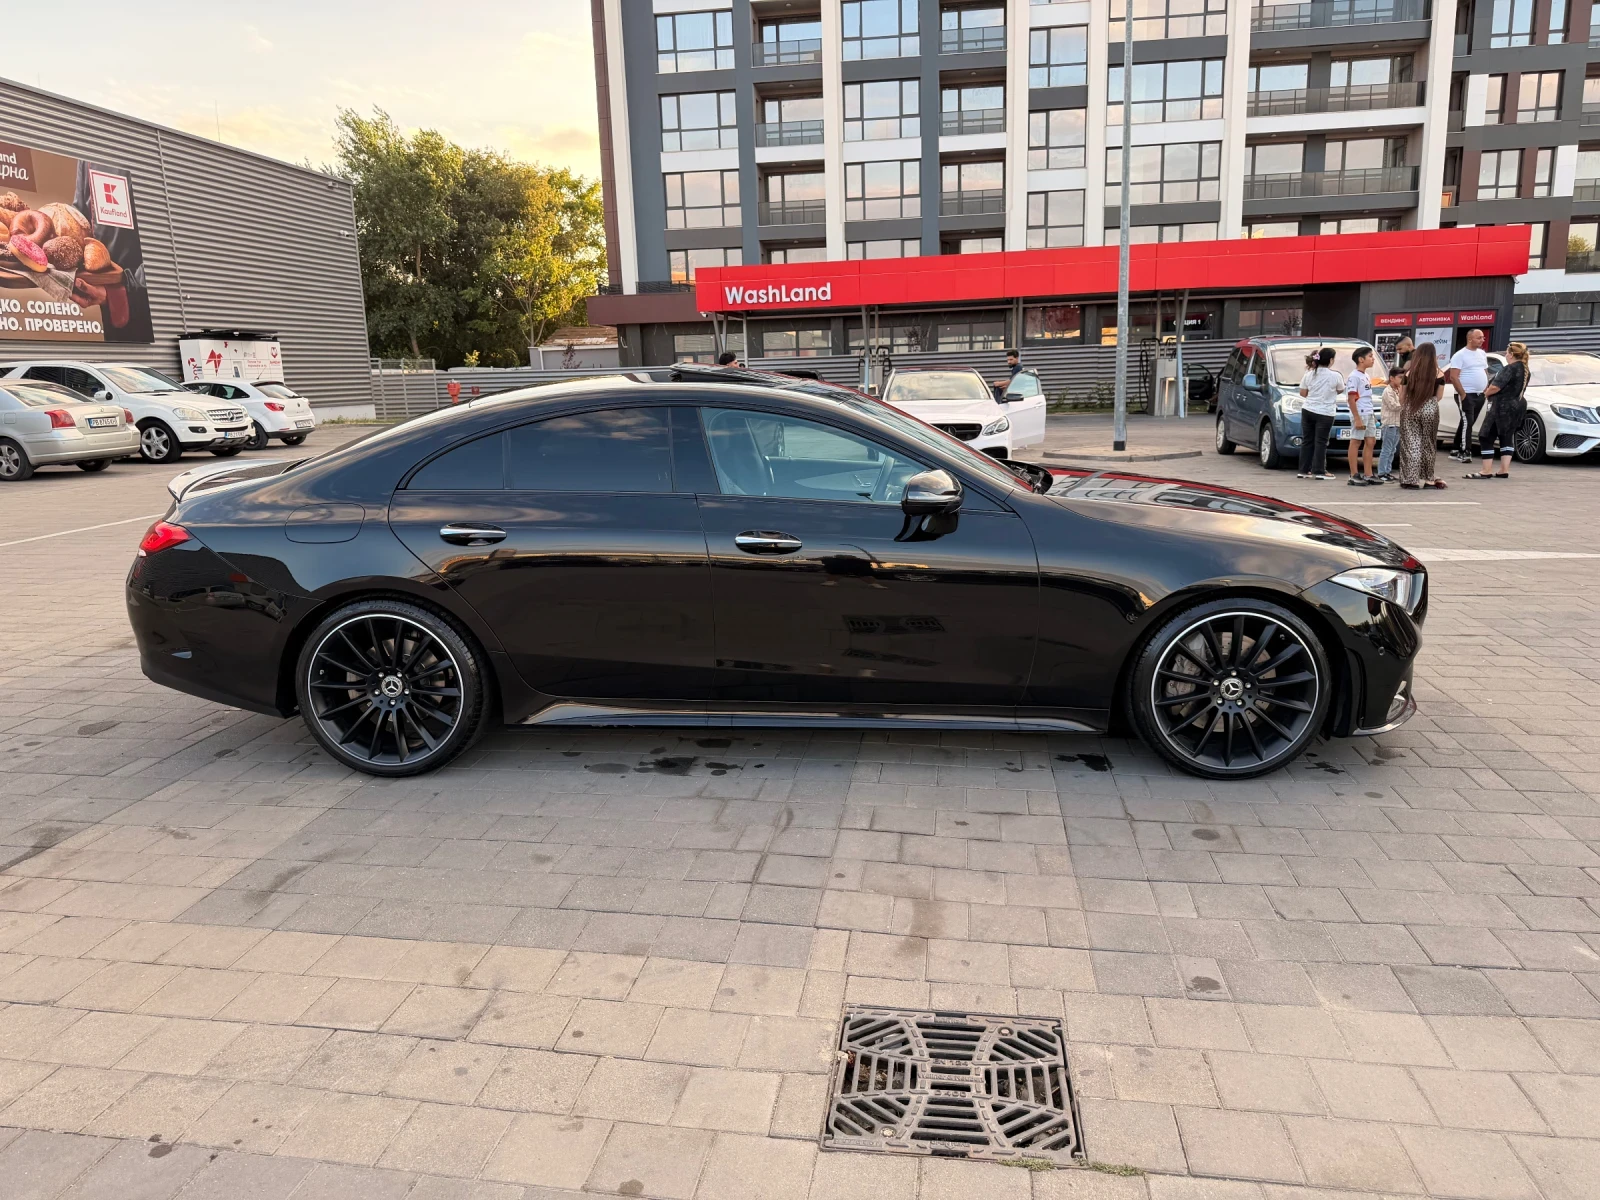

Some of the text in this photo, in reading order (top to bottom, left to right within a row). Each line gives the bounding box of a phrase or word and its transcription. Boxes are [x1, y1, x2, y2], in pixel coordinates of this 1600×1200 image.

[100, 206, 128, 218] Kaufland
[724, 282, 831, 305] WashLand
[26, 300, 84, 316] СОЛЕНО.
[24, 317, 104, 334] ПРОВЕРЕНО.
